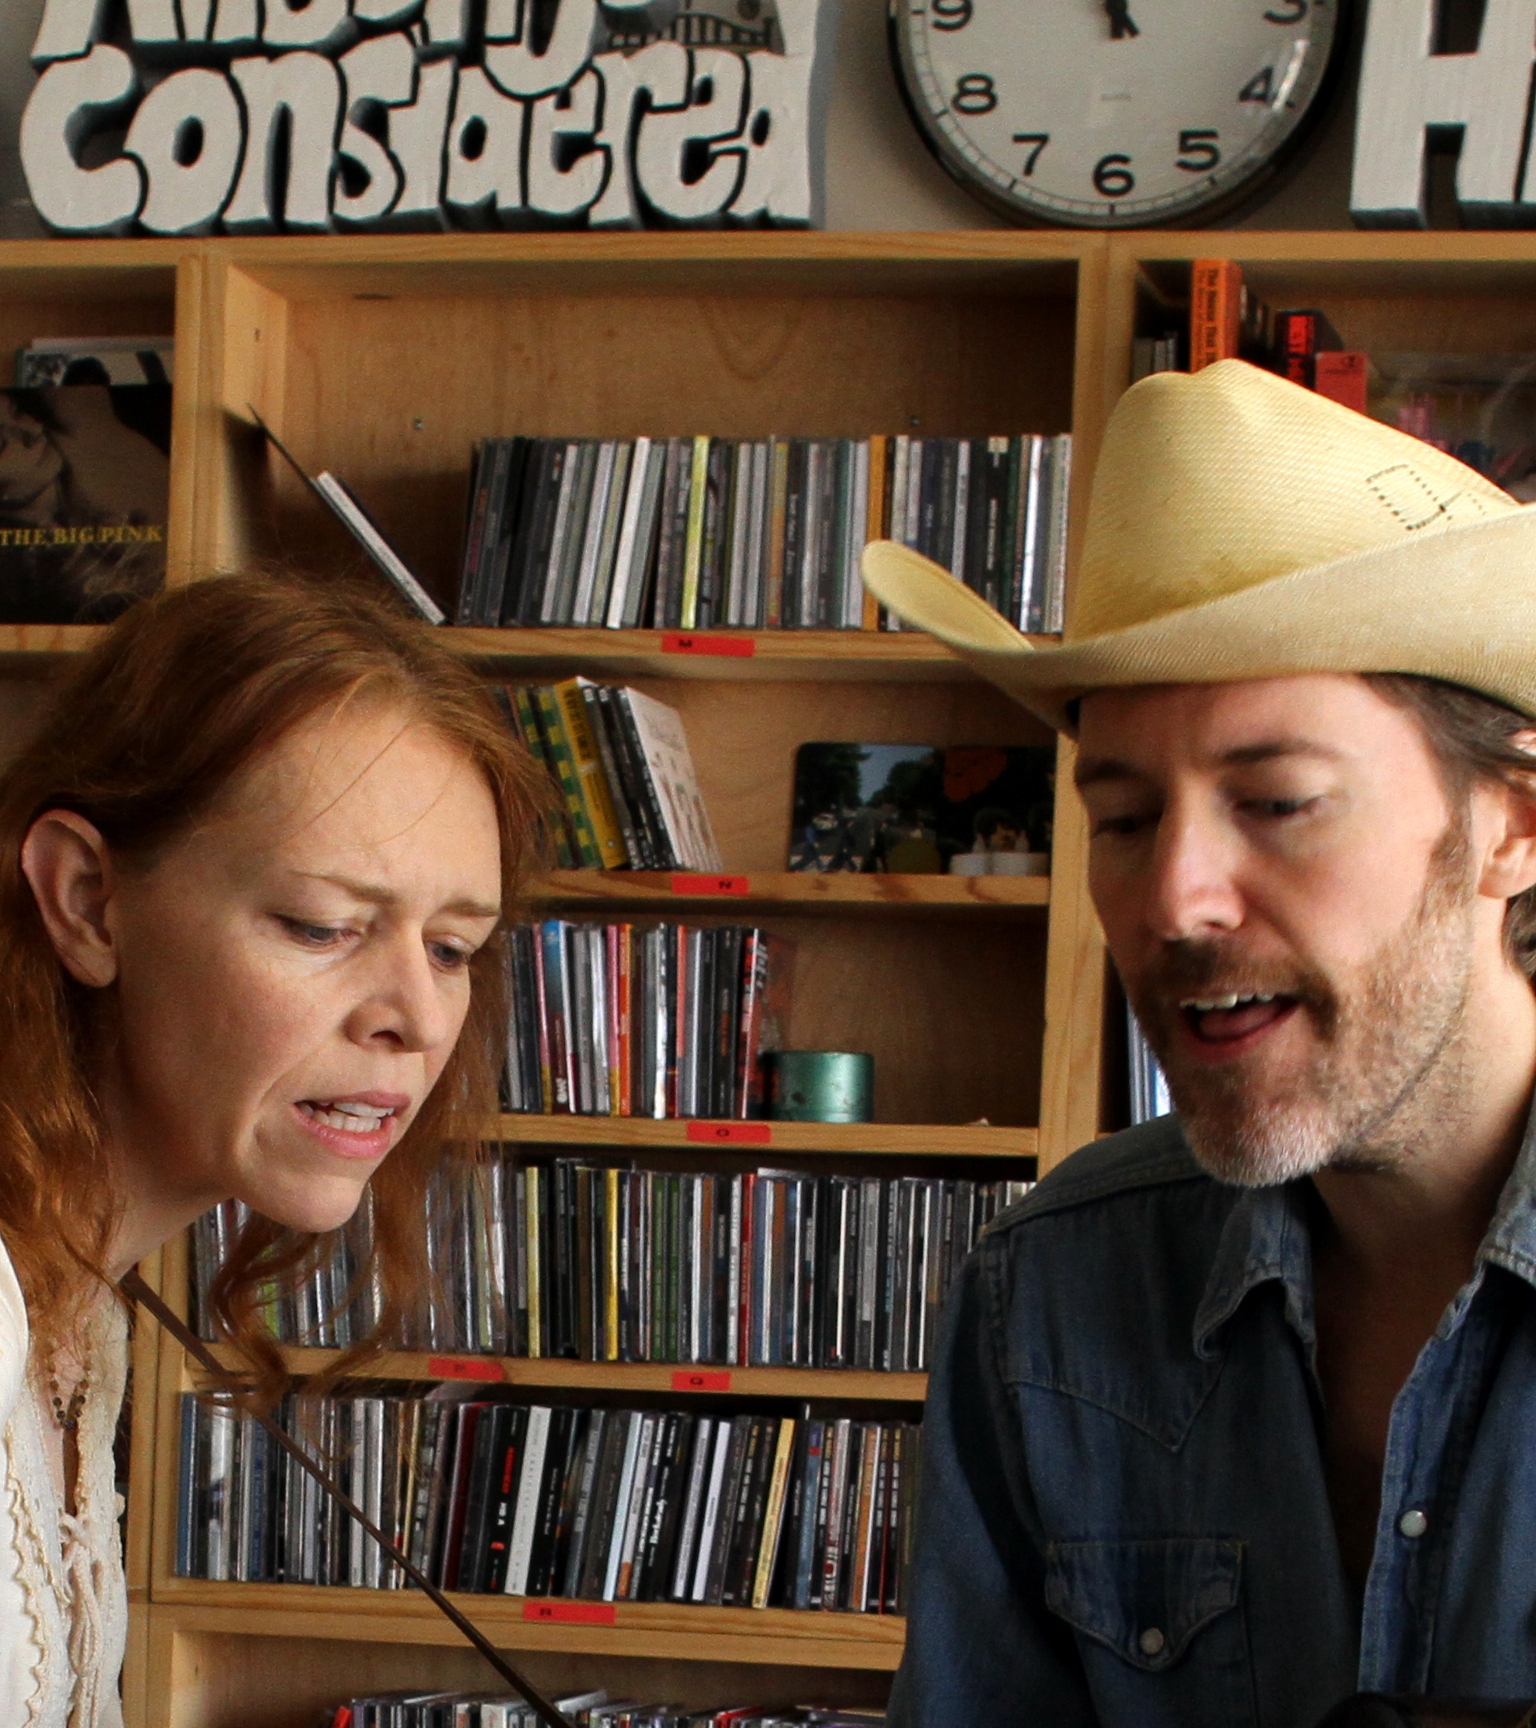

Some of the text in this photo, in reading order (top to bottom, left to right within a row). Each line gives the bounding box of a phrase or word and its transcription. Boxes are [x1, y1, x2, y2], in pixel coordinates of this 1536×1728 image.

[951, 73, 999, 115] 8
[1237, 65, 1276, 106] 4
[20, 0, 815, 232] Considered
[1010, 133, 1051, 175] 7
[1176, 129, 1222, 171] 5
[1092, 153, 1136, 195] 6
[54, 527, 94, 544] BIG
[102, 525, 162, 542] PINK
